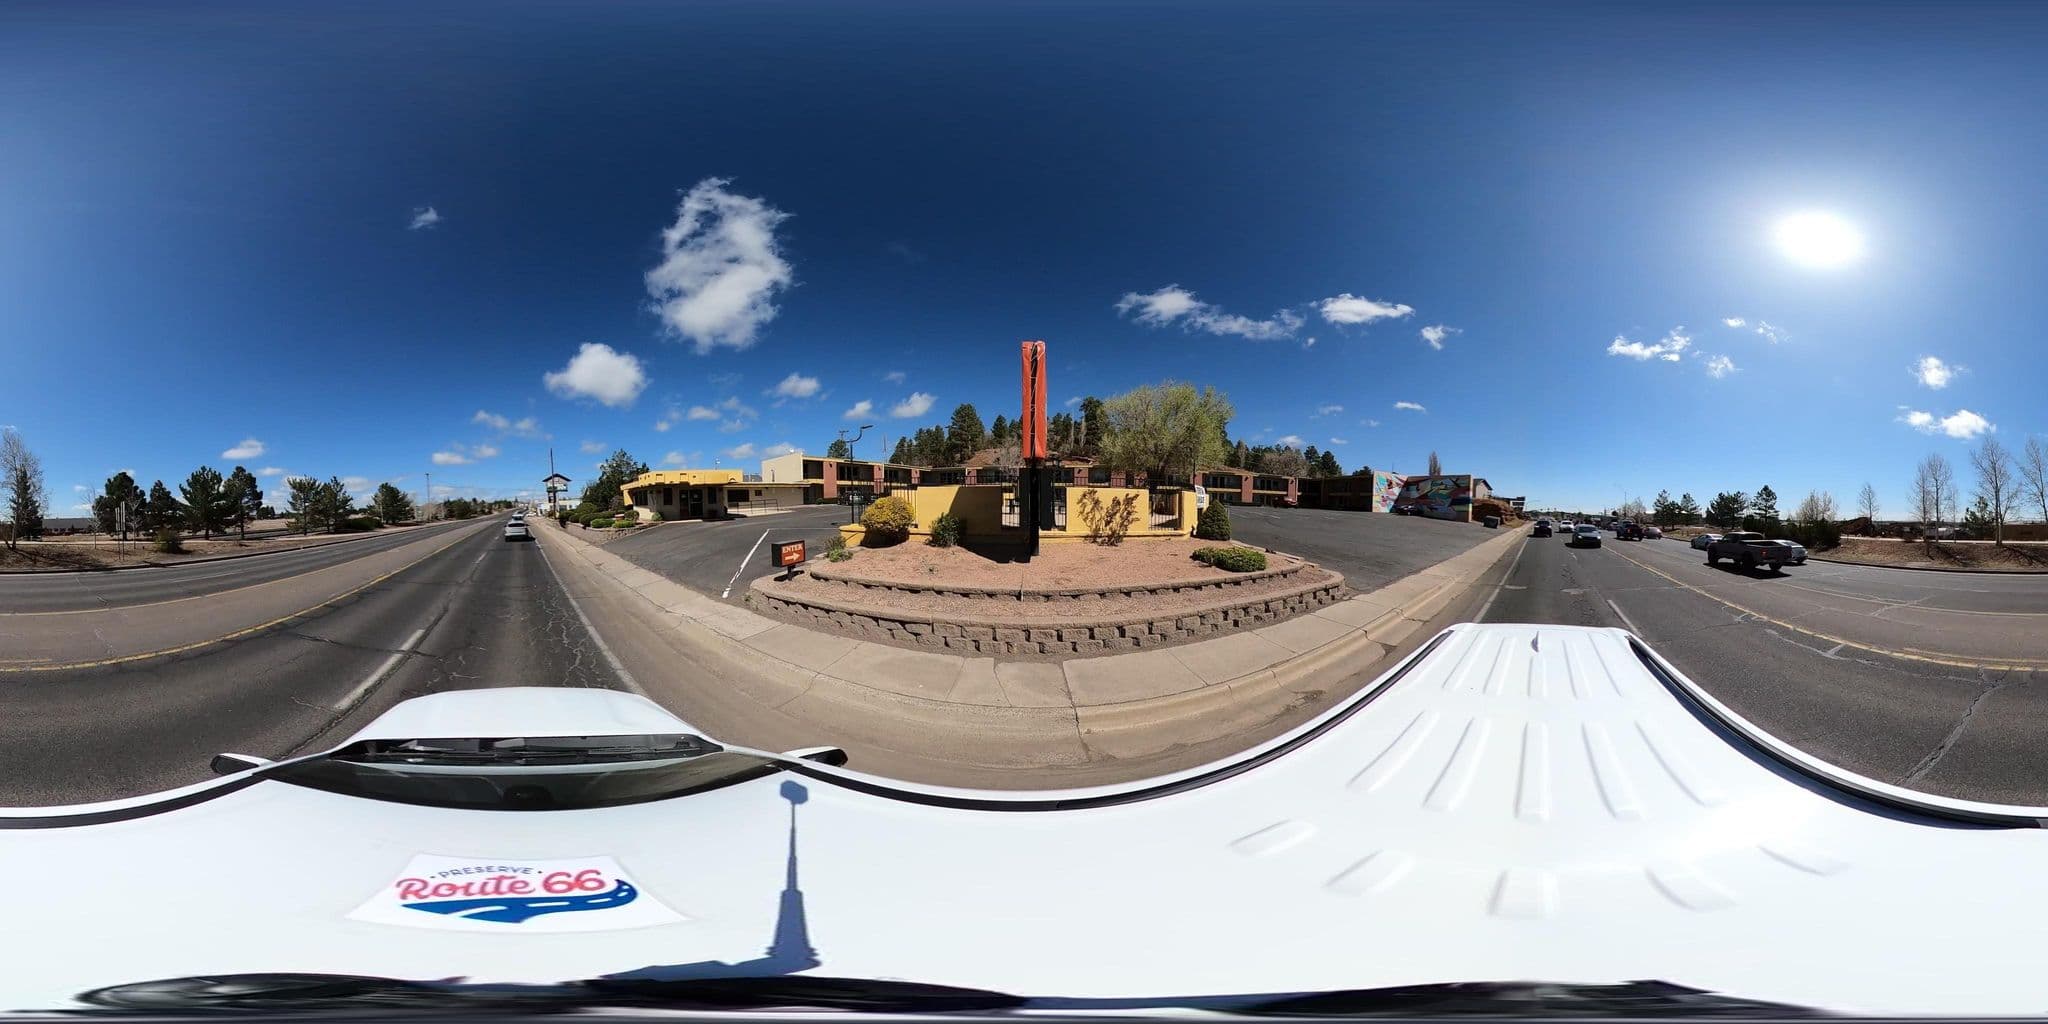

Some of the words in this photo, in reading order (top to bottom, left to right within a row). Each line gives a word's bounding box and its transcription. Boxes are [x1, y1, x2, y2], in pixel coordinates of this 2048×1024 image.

[782, 544, 803, 554] ENTER
[438, 865, 533, 880] PRESERVE
[396, 875, 536, 901] Route
[542, 869, 606, 894] 66
